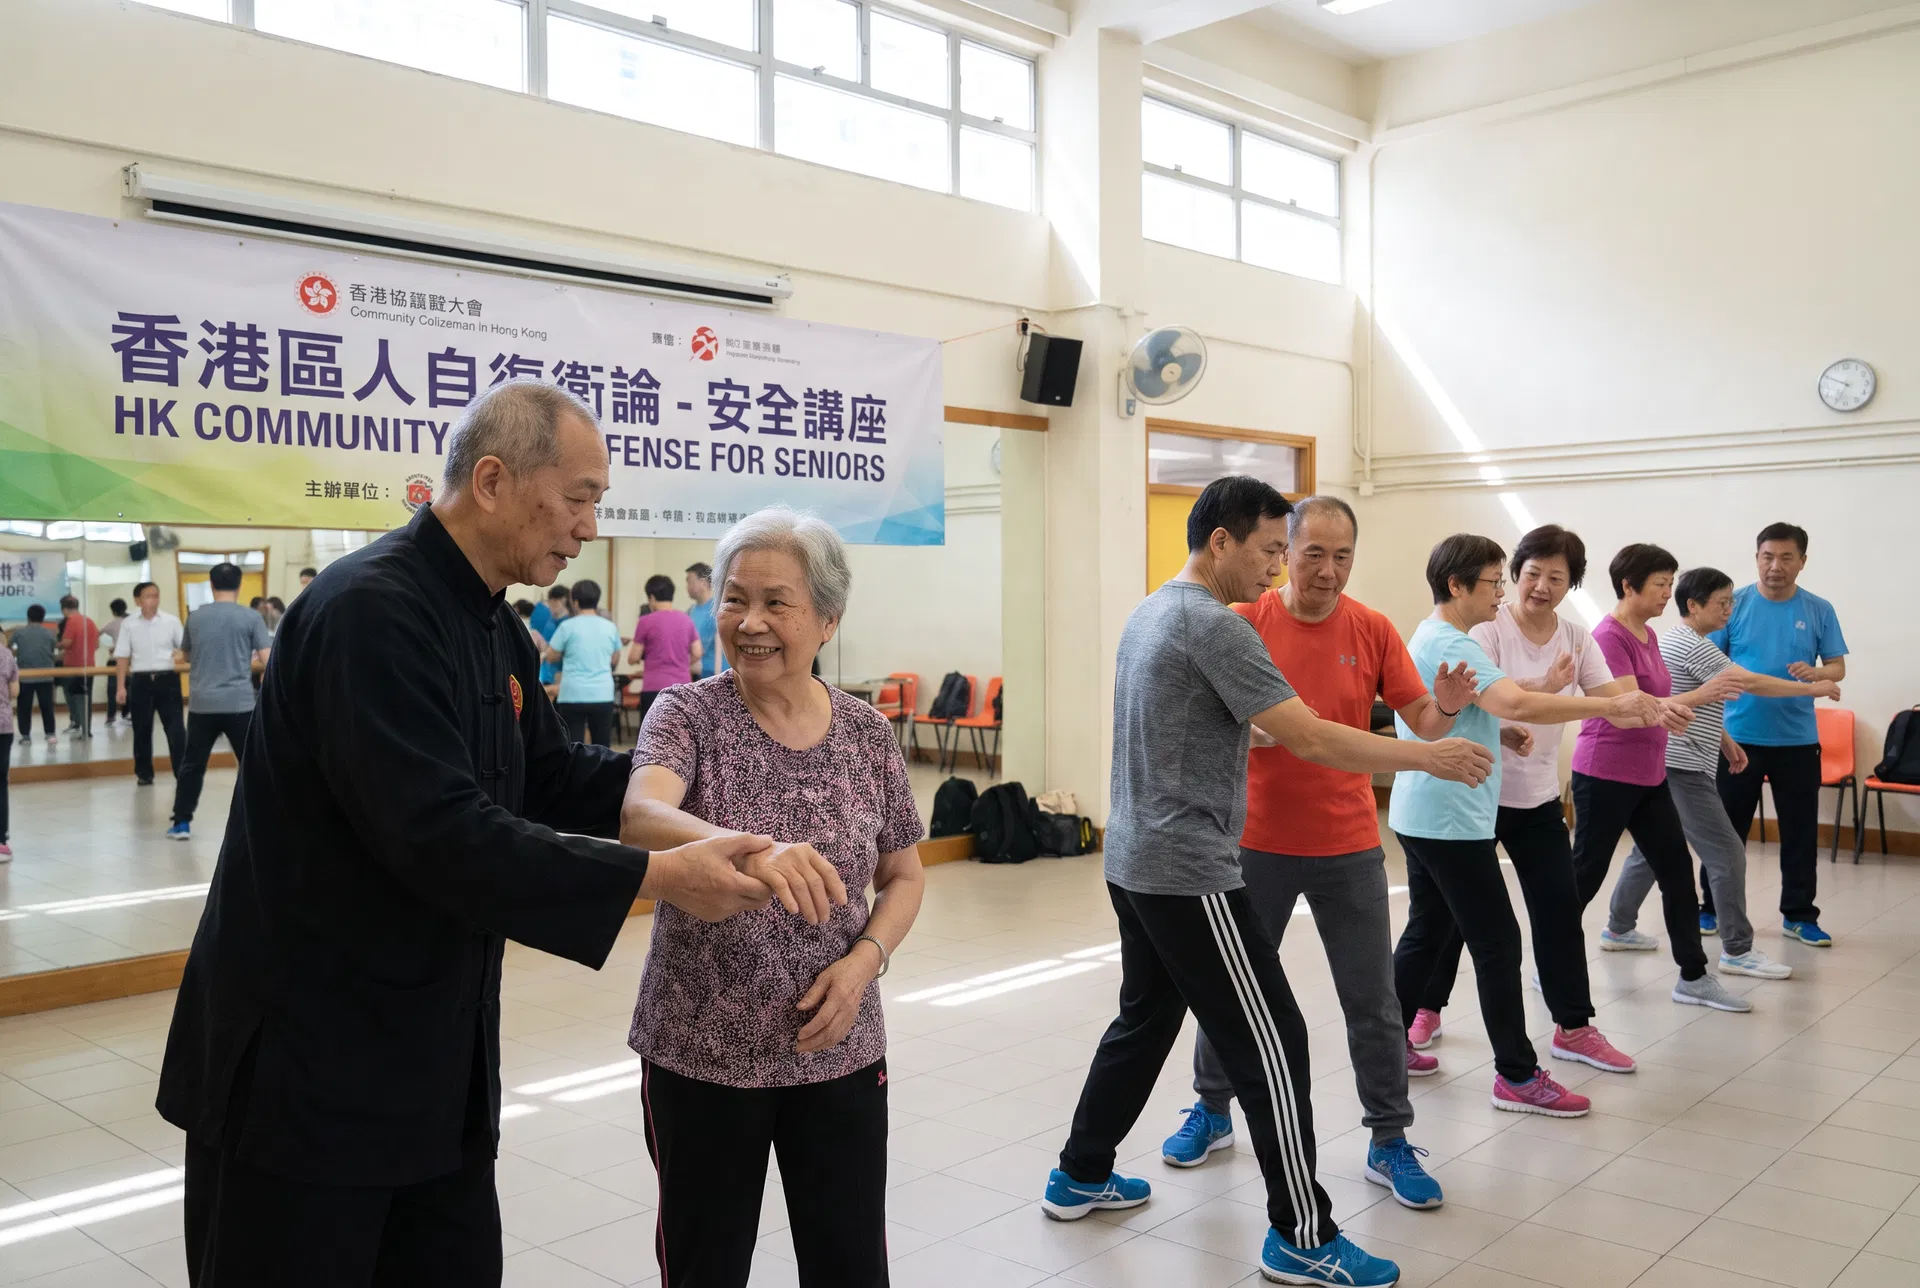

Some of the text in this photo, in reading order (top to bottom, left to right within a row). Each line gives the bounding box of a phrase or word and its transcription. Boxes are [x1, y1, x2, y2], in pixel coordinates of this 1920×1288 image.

[350, 306, 416, 326] Community
[419, 315, 476, 332] Colizeman
[490, 323, 518, 339] Hong
[521, 327, 547, 342] Kong
[114, 395, 886, 483] HK COMMUNITY FENSE FOR SENIORS
[707, 378, 887, 445] 安全講座
